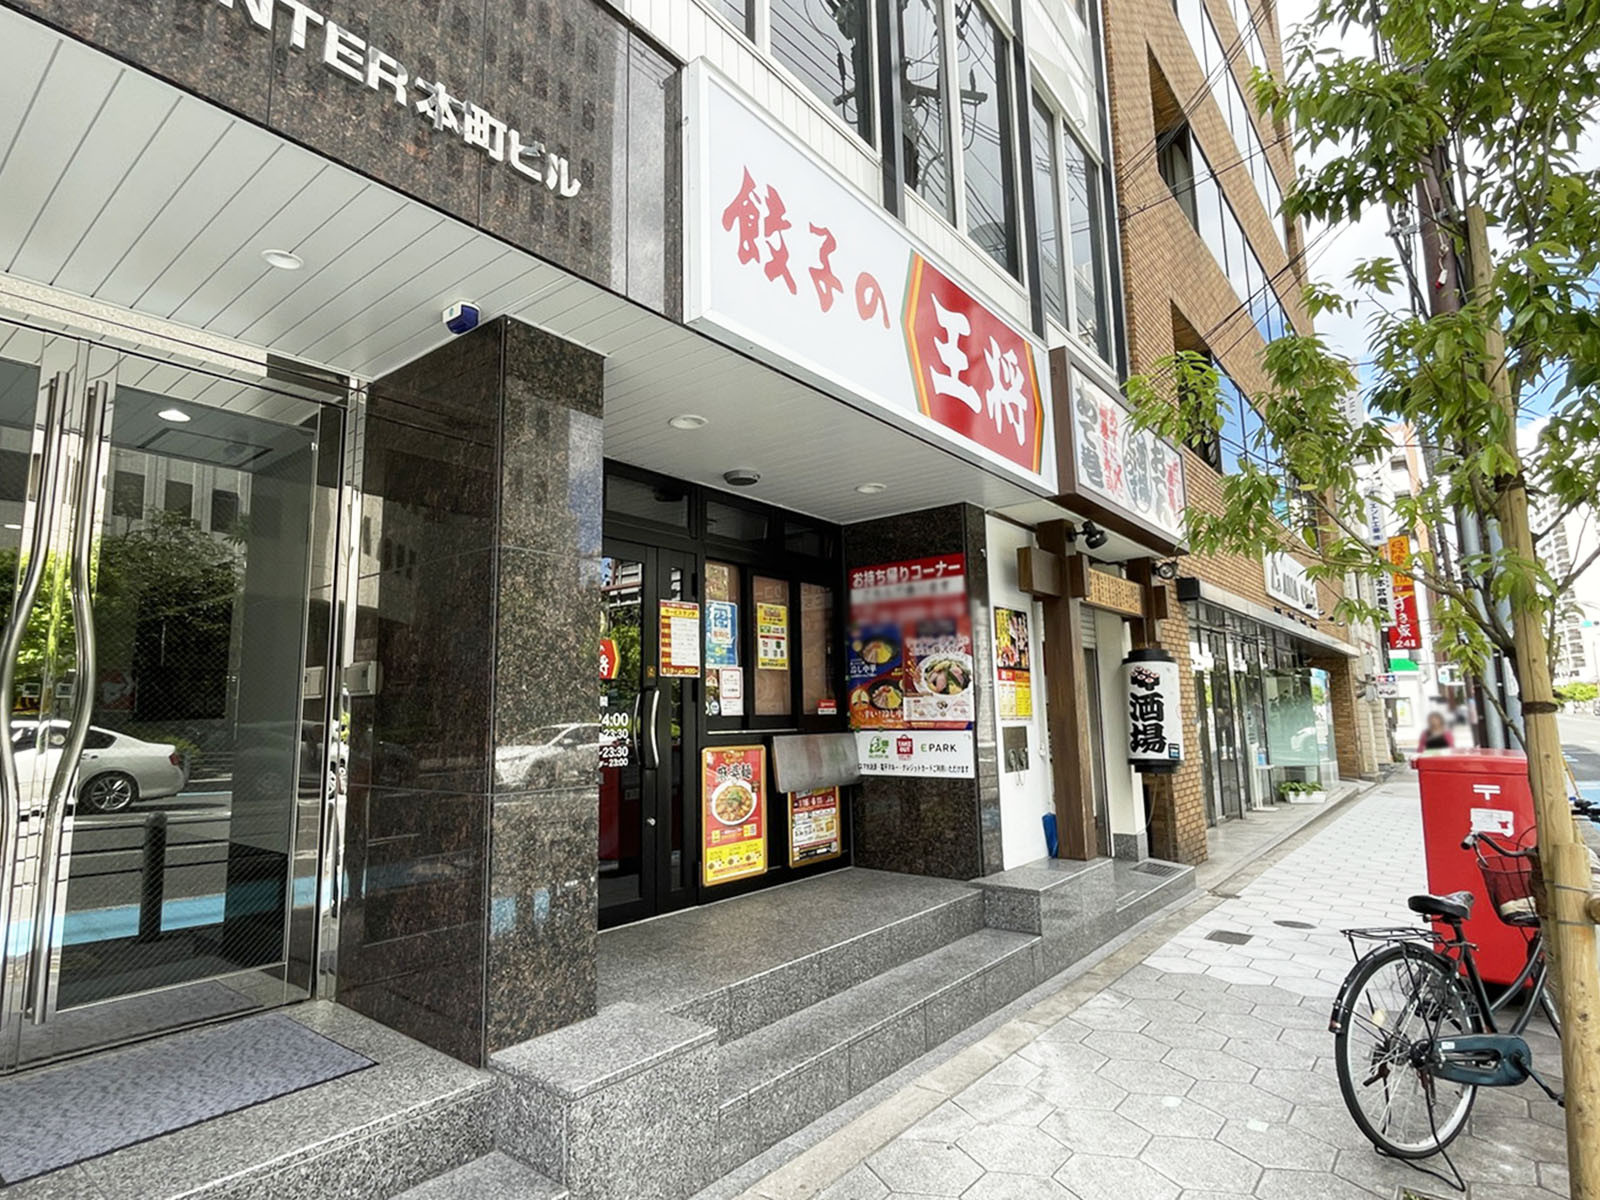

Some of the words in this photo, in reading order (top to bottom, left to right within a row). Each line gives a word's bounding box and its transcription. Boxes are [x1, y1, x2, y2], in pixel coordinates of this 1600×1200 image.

[852, 561, 961, 588] お持ち帰りコーナー
[1129, 691, 1167, 754] 酒場
